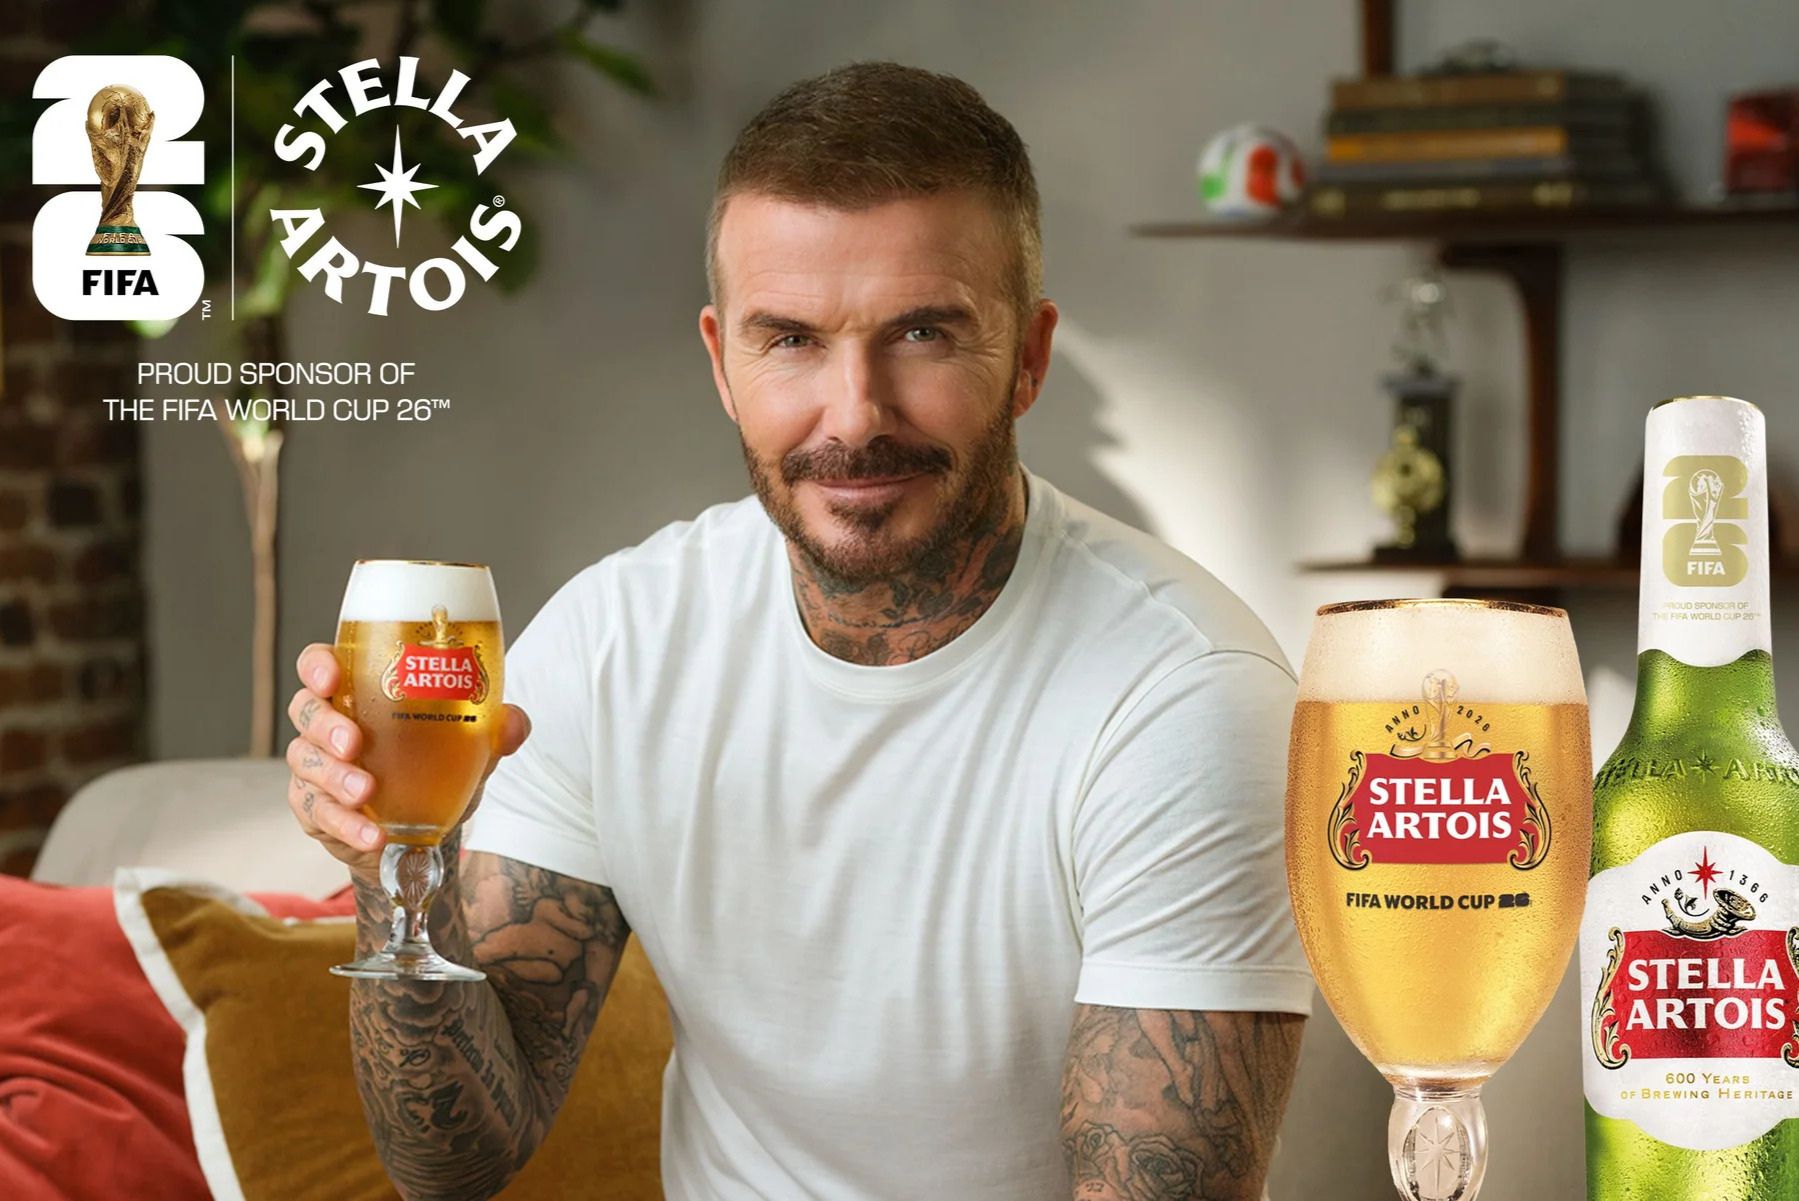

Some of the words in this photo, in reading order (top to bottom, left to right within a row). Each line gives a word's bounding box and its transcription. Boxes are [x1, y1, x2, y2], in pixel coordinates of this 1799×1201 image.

[1687, 561, 1726, 575] FIFA
[1664, 602, 1693, 610] PROUD
[1694, 602, 1735, 610] SPONSOR
[1737, 602, 1749, 610] OF
[1653, 612, 1668, 620] THE
[1671, 612, 1688, 620] FIFA
[1690, 612, 1721, 620] WORLD
[1723, 612, 1742, 620] CUP
[406, 655, 473, 672] STELLA
[403, 673, 473, 689] ARTOIS
[392, 712, 411, 720] FIFA
[413, 712, 444, 721] WORLD
[446, 713, 462, 722] CUP
[1385, 705, 1420, 733] ANNO
[1457, 705, 1491, 733] 2026
[1369, 778, 1512, 806] STELLA
[1367, 811, 1512, 840] ARTOIS
[1641, 869, 1683, 905] ANNO
[1729, 870, 1769, 903] 1366
[1346, 892, 1382, 909] FIFA
[1384, 893, 1453, 910] WORLD
[1457, 893, 1495, 910] CUP
[1628, 958, 1785, 991] STELLA
[1625, 997, 1786, 1031] ARTOIS
[1665, 1073, 1695, 1084] 600
